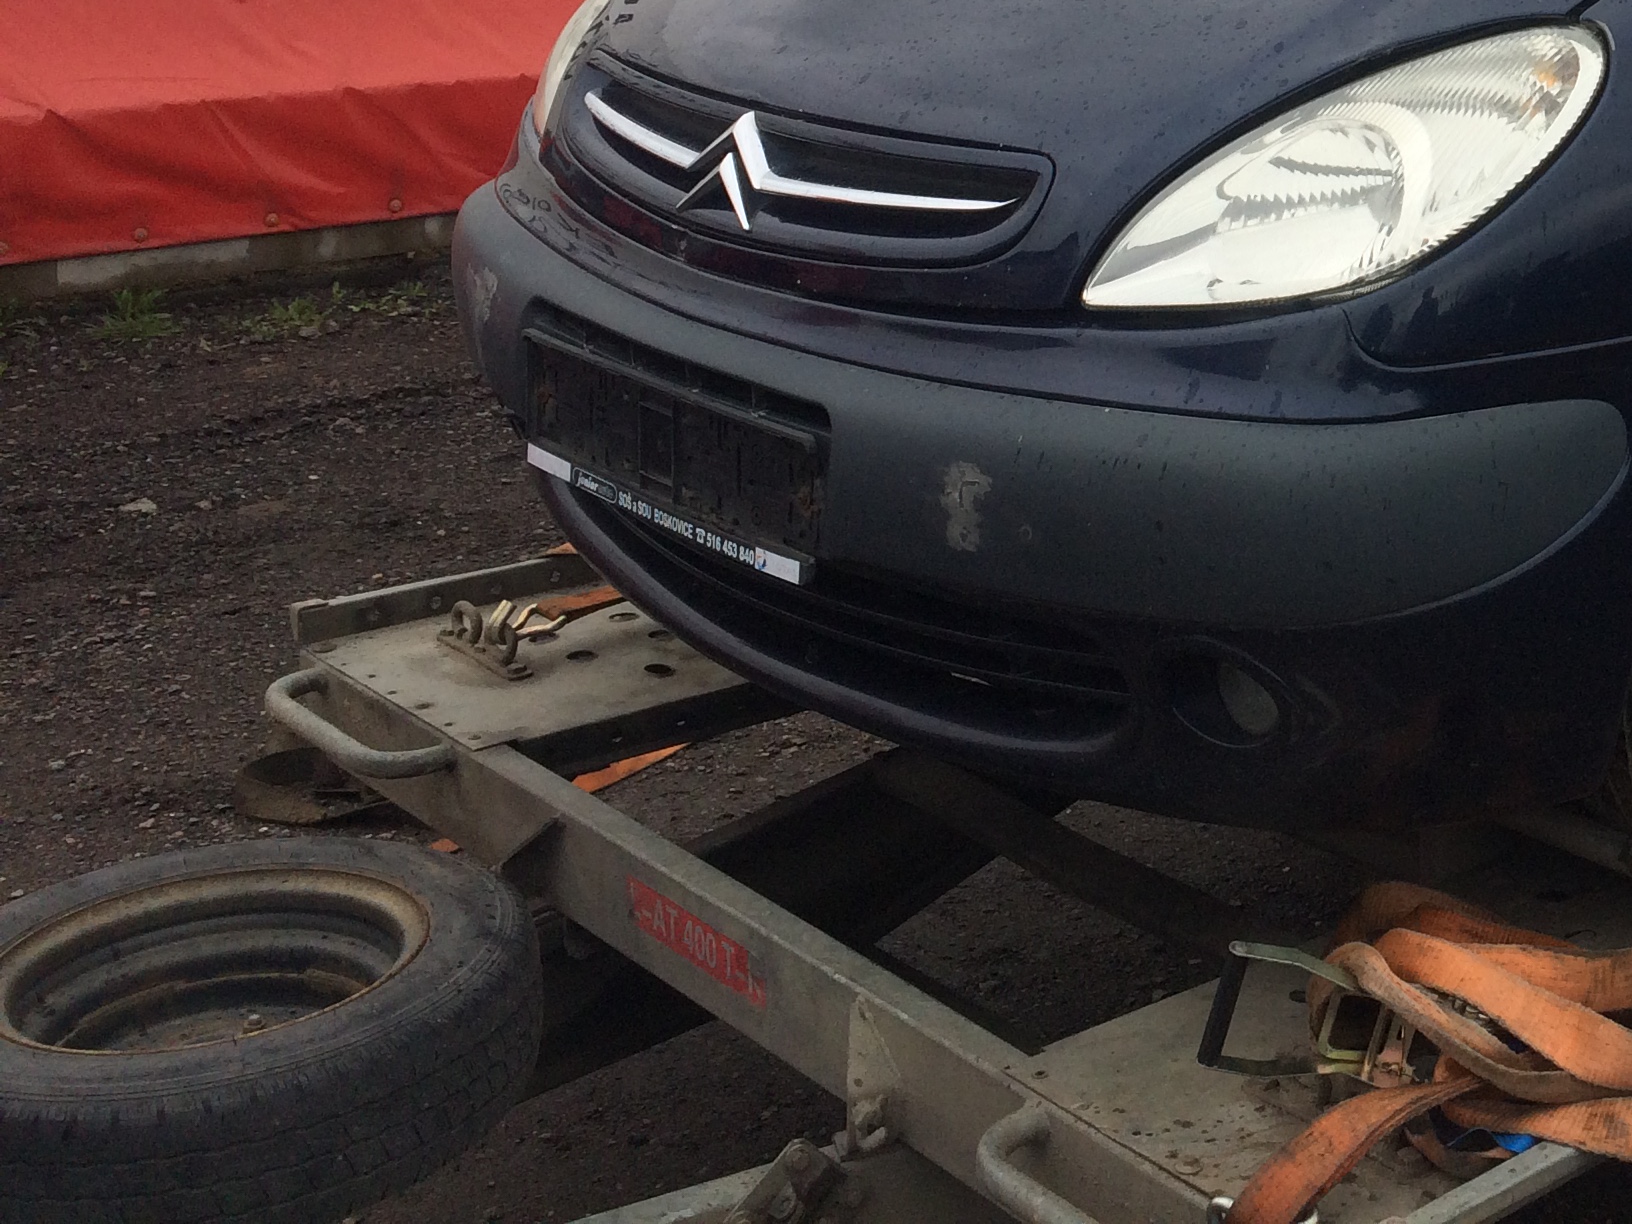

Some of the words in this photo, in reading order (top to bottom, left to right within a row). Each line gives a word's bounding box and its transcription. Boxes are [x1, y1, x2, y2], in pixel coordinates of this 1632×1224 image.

[653, 508, 694, 539] BOSKOVICE
[705, 532, 721, 552] 516
[722, 539, 738, 558] 453
[738, 545, 755, 565] 840
[683, 920, 717, 968] 400
